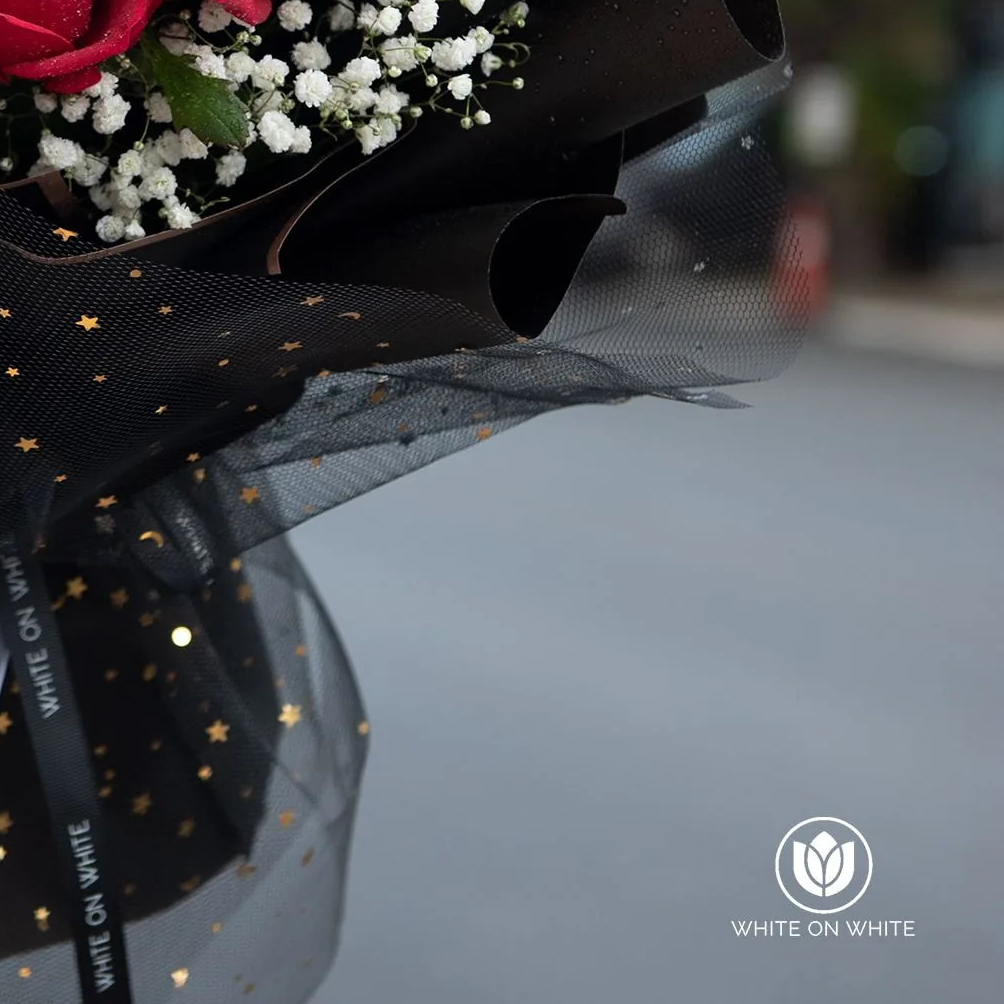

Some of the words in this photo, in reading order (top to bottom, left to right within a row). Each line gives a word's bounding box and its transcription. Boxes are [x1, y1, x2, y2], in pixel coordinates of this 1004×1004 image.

[15, 605, 42, 642] ON
[25, 648, 61, 719] WHITE
[67, 819, 100, 890] WHITE
[84, 893, 108, 926] ON
[94, 931, 115, 993] WHITE
